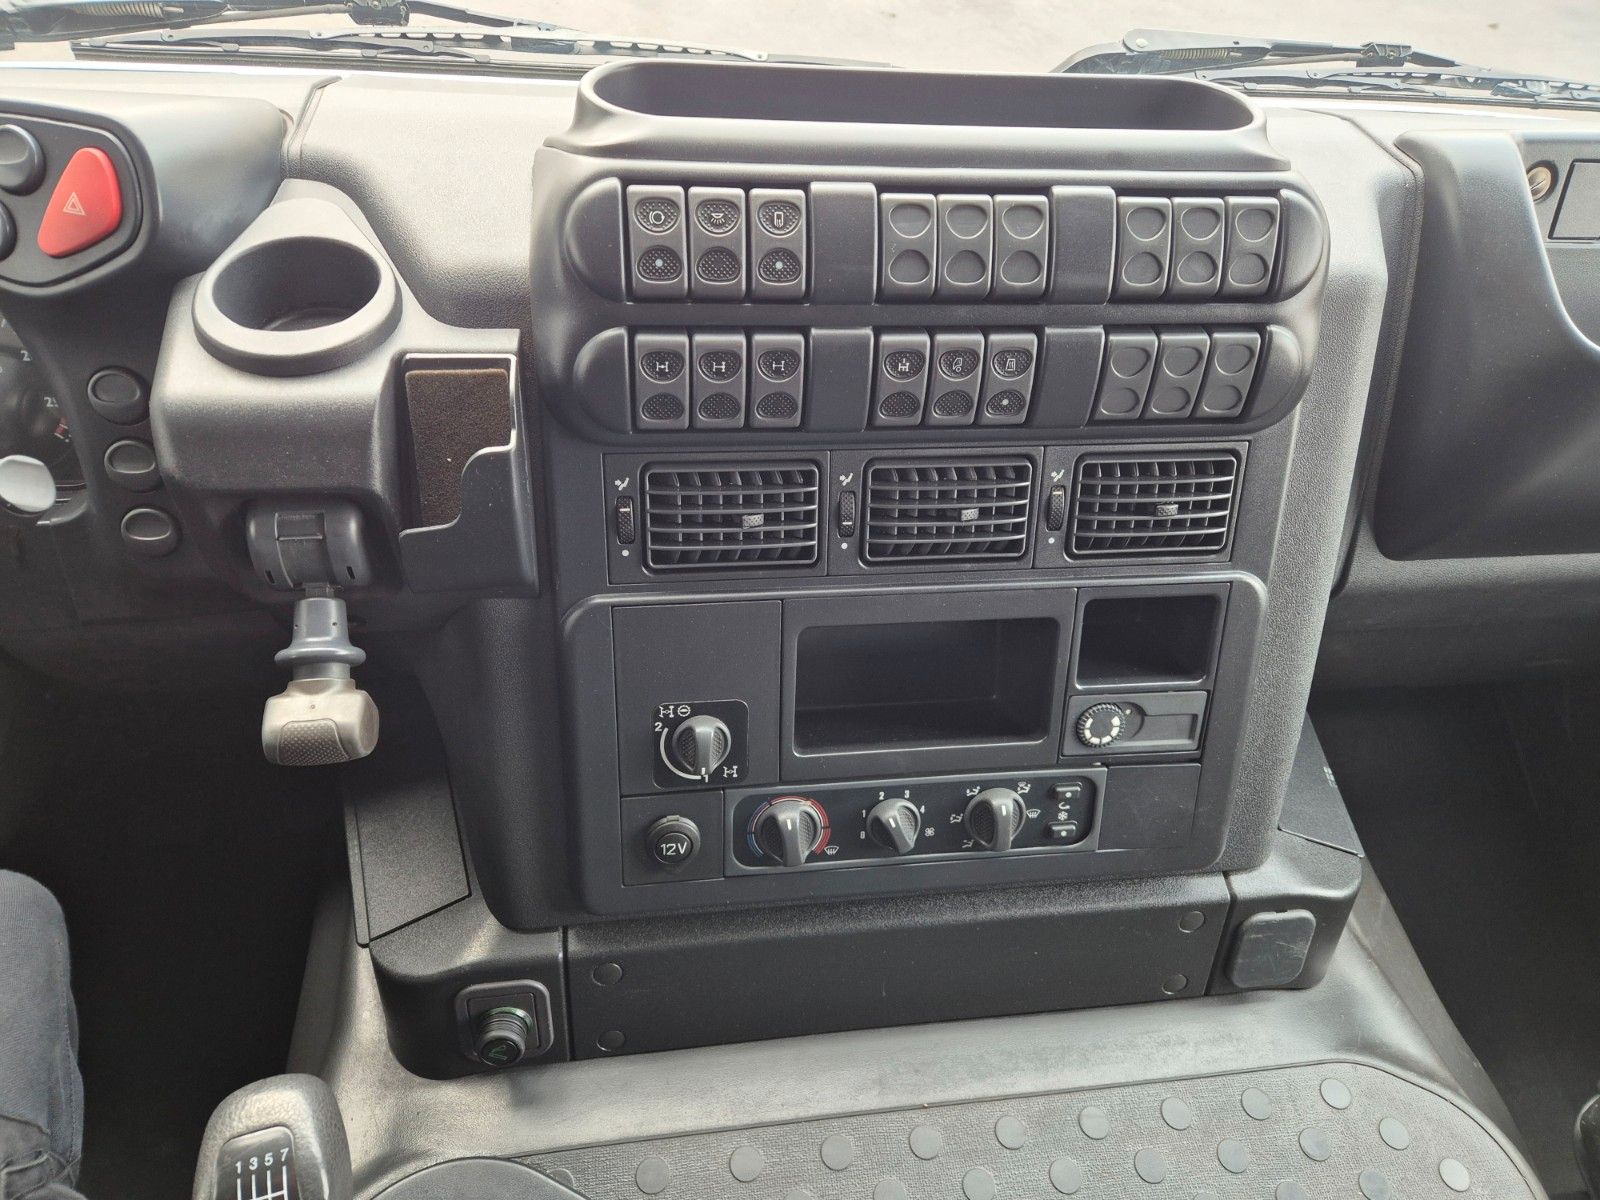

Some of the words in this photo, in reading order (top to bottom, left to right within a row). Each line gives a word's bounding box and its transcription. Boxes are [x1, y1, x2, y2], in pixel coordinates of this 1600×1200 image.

[20, 349, 31, 361] 2
[655, 722, 662, 732] 2
[879, 791, 885, 800] 2
[904, 790, 910, 799] 3
[862, 809, 866, 818] 1
[919, 805, 925, 814] 4
[660, 841, 688, 856] 12V
[235, 1161, 242, 1174] 1
[249, 1156, 258, 1170] 3
[264, 1152, 273, 1166] 5
[280, 1147, 289, 1162] 7
